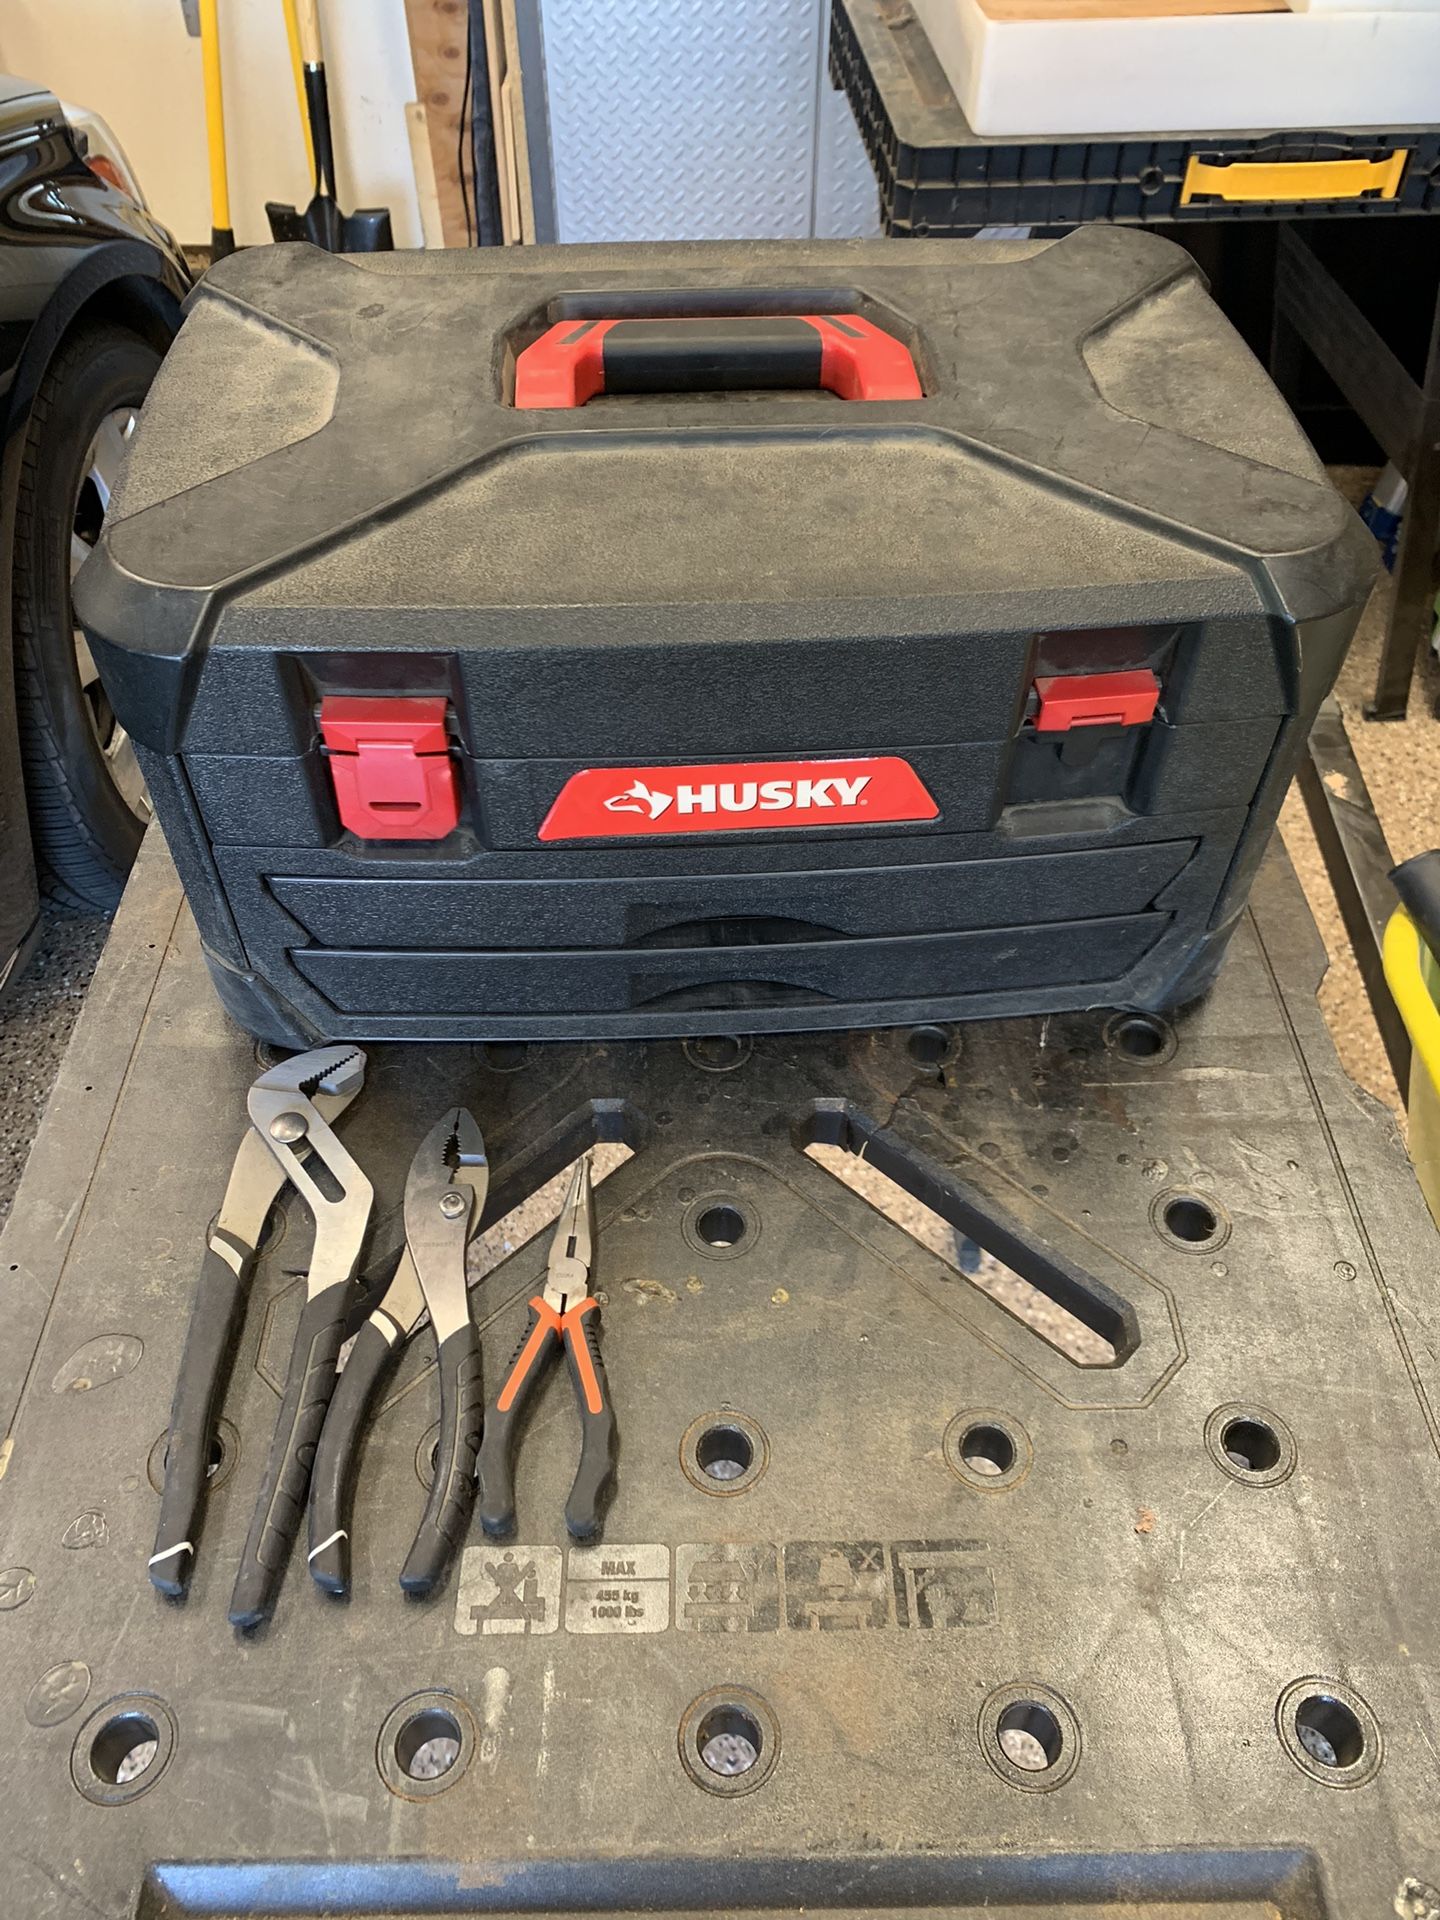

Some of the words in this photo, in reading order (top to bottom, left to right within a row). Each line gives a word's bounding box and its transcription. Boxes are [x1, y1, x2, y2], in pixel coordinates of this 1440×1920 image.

[677, 776, 872, 814] HUSKY
[601, 1561, 636, 1576] MAX
[596, 1589, 620, 1602] 455
[623, 1589, 640, 1604] kg
[591, 1605, 622, 1618] 1000
[625, 1605, 644, 1618] lbs
